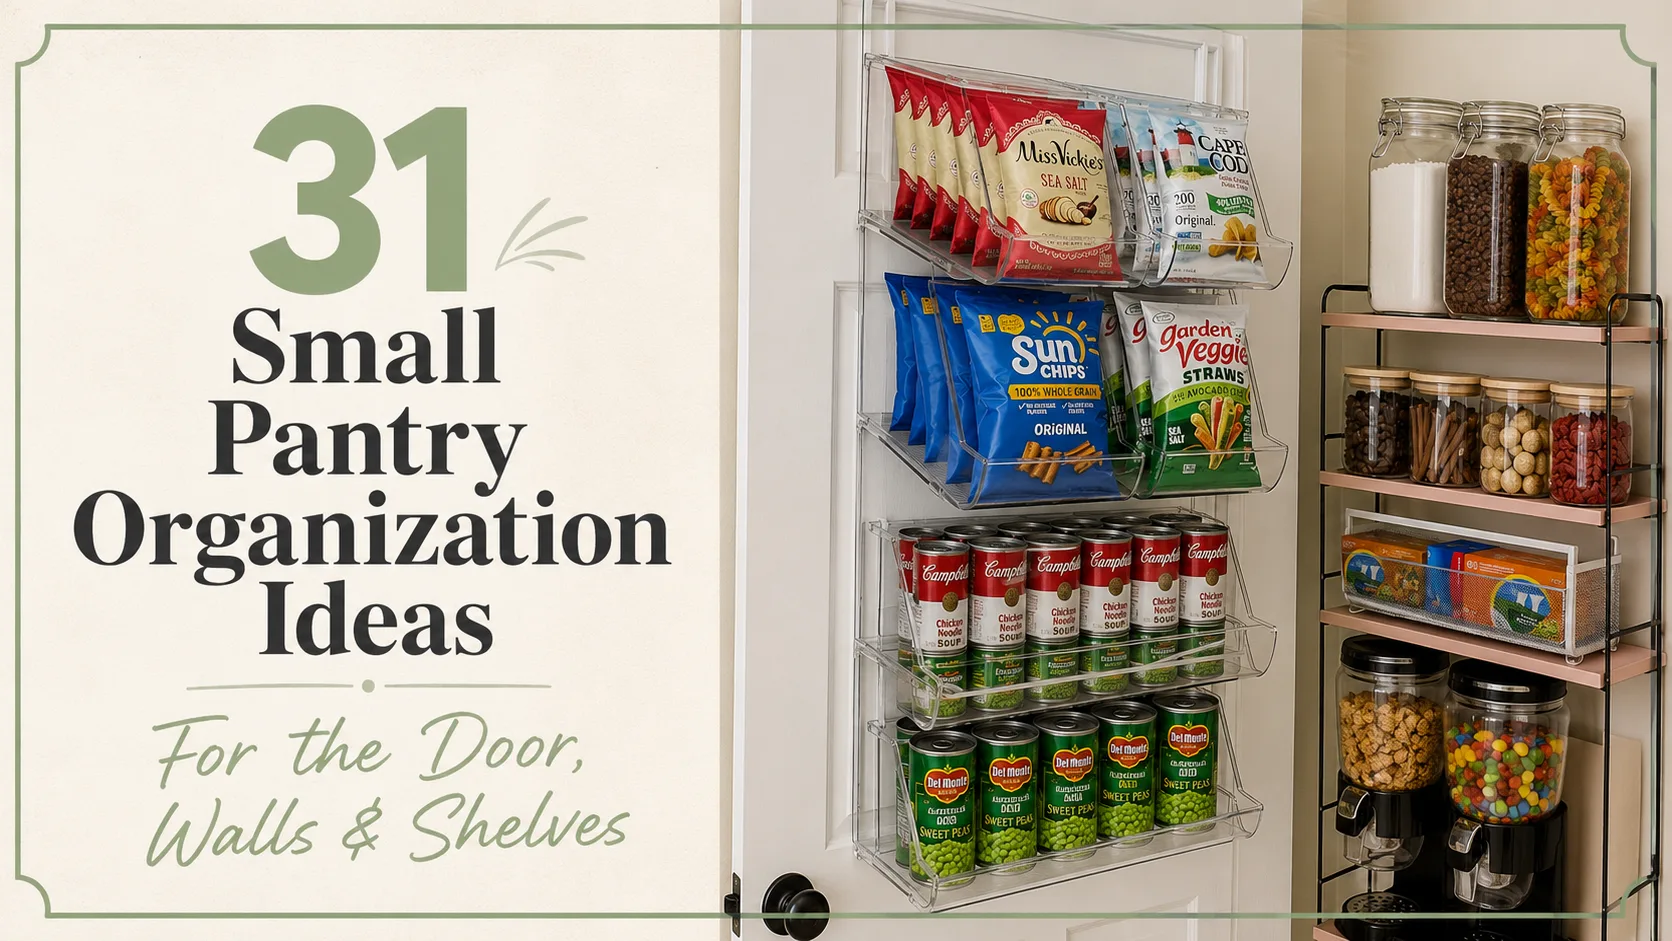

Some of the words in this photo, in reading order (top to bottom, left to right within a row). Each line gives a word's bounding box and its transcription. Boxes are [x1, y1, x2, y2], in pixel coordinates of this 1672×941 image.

[1198, 135, 1246, 156] CAPE
[1016, 140, 1056, 164] Miss
[1050, 139, 1104, 176] Vickie's
[1209, 152, 1249, 174] COD
[1040, 173, 1062, 188] SEA
[1066, 175, 1088, 191] SALT
[1174, 192, 1195, 205] 200
[1159, 319, 1233, 352] garden
[1011, 335, 1078, 375] Sun
[1175, 339, 1249, 369] Veggie
[1040, 364, 1086, 379] CHIPS
[1183, 366, 1244, 385] STRAWS
[1014, 387, 1040, 397] 100%
[1042, 387, 1072, 397] WHOLE
[1074, 387, 1098, 397] GRAIN
[1187, 386, 1229, 398] AVOCADO
[1168, 426, 1182, 435] SEA
[1168, 434, 1185, 445] SALT
[1170, 732, 1183, 742] Del
[1110, 744, 1123, 754] Del
[1055, 758, 1068, 768] Del
[992, 766, 1006, 777] Del
[927, 777, 941, 788] Del
[1163, 779, 1191, 789] SWEET
[1192, 779, 1211, 789] PEAS
[1103, 789, 1130, 801] SWEET
[1132, 789, 1150, 801] PEAS
[1047, 804, 1075, 816] SWEET
[1077, 802, 1095, 814] PEAS
[984, 814, 1013, 827] SWEET
[1016, 813, 1033, 826] PEAS
[920, 826, 948, 839] SWEET
[952, 824, 971, 837] PEAS
